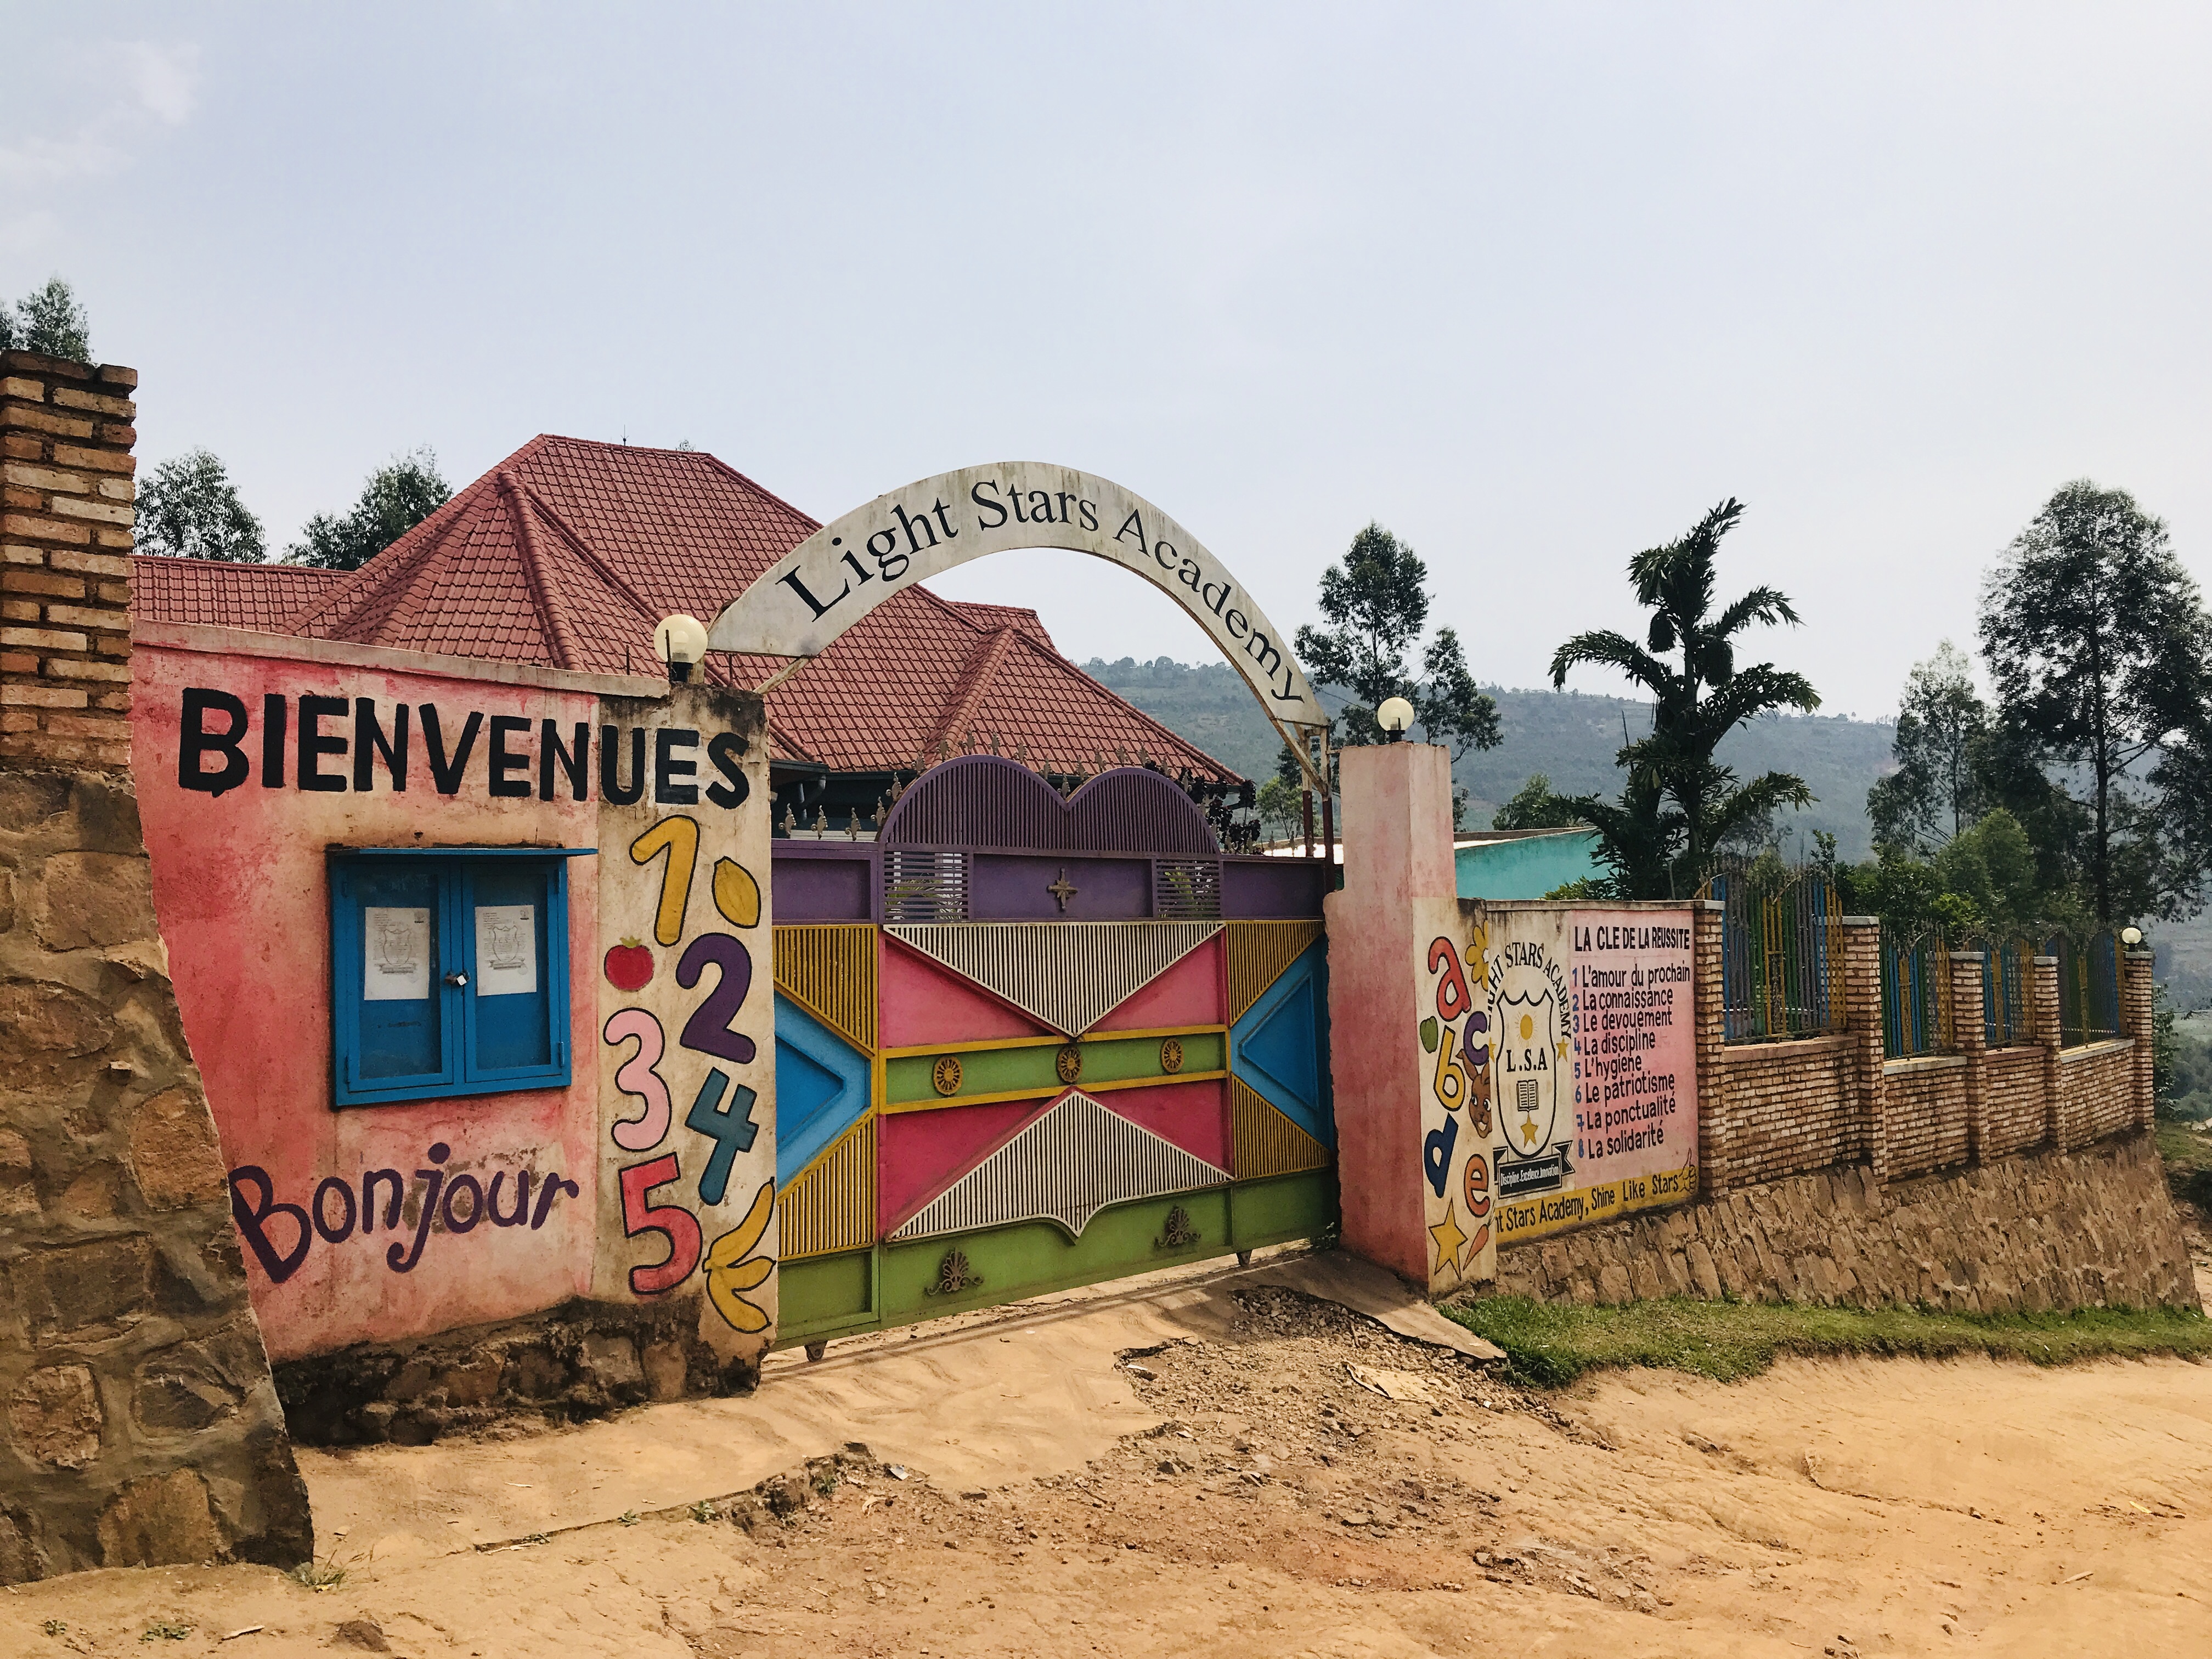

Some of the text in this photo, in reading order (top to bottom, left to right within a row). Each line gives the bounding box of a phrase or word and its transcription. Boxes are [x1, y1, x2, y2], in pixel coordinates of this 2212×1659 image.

[775, 479, 1304, 705] Light Stars Academy
[178, 687, 751, 811] BIENVENUES
[629, 815, 701, 947] 1
[1575, 926, 1690, 951] LA CLE DE LA REUSSITE
[676, 932, 757, 1064] 2
[1427, 936, 1471, 1022] a
[1505, 942, 1544, 969] STARS
[1542, 957, 1571, 1039] ACADEMY
[1572, 960, 1690, 990] 1 L'amour du prochain
[1572, 987, 1673, 1012] 2 La connaissance
[1463, 1011, 1489, 1066] c
[1572, 1006, 1672, 1033] 3 Le devouement
[1574, 1028, 1655, 1056] 4 La discipline
[603, 1007, 673, 1151] 3
[1575, 1053, 1641, 1081] 5 L'hygiene
[1575, 1070, 1675, 1107] 6 Le patriotisme
[685, 1068, 759, 1206] 4
[1576, 1091, 1675, 1134] 7 La ponctualité
[1588, 1139, 1603, 1159] La
[1607, 1119, 1664, 1155] solidarité
[1424, 1113, 1459, 1198] d
[1464, 1153, 1491, 1218] e
[228, 1142, 580, 1284] Bonjour
[619, 1153, 703, 1295] 5
[1506, 1207, 1536, 1231] Stars
[1539, 1196, 1589, 1223] Academy,
[1592, 1186, 1615, 1210] Shine
[1623, 1180, 1645, 1201] Like
[1652, 1173, 1679, 1195] Stars
